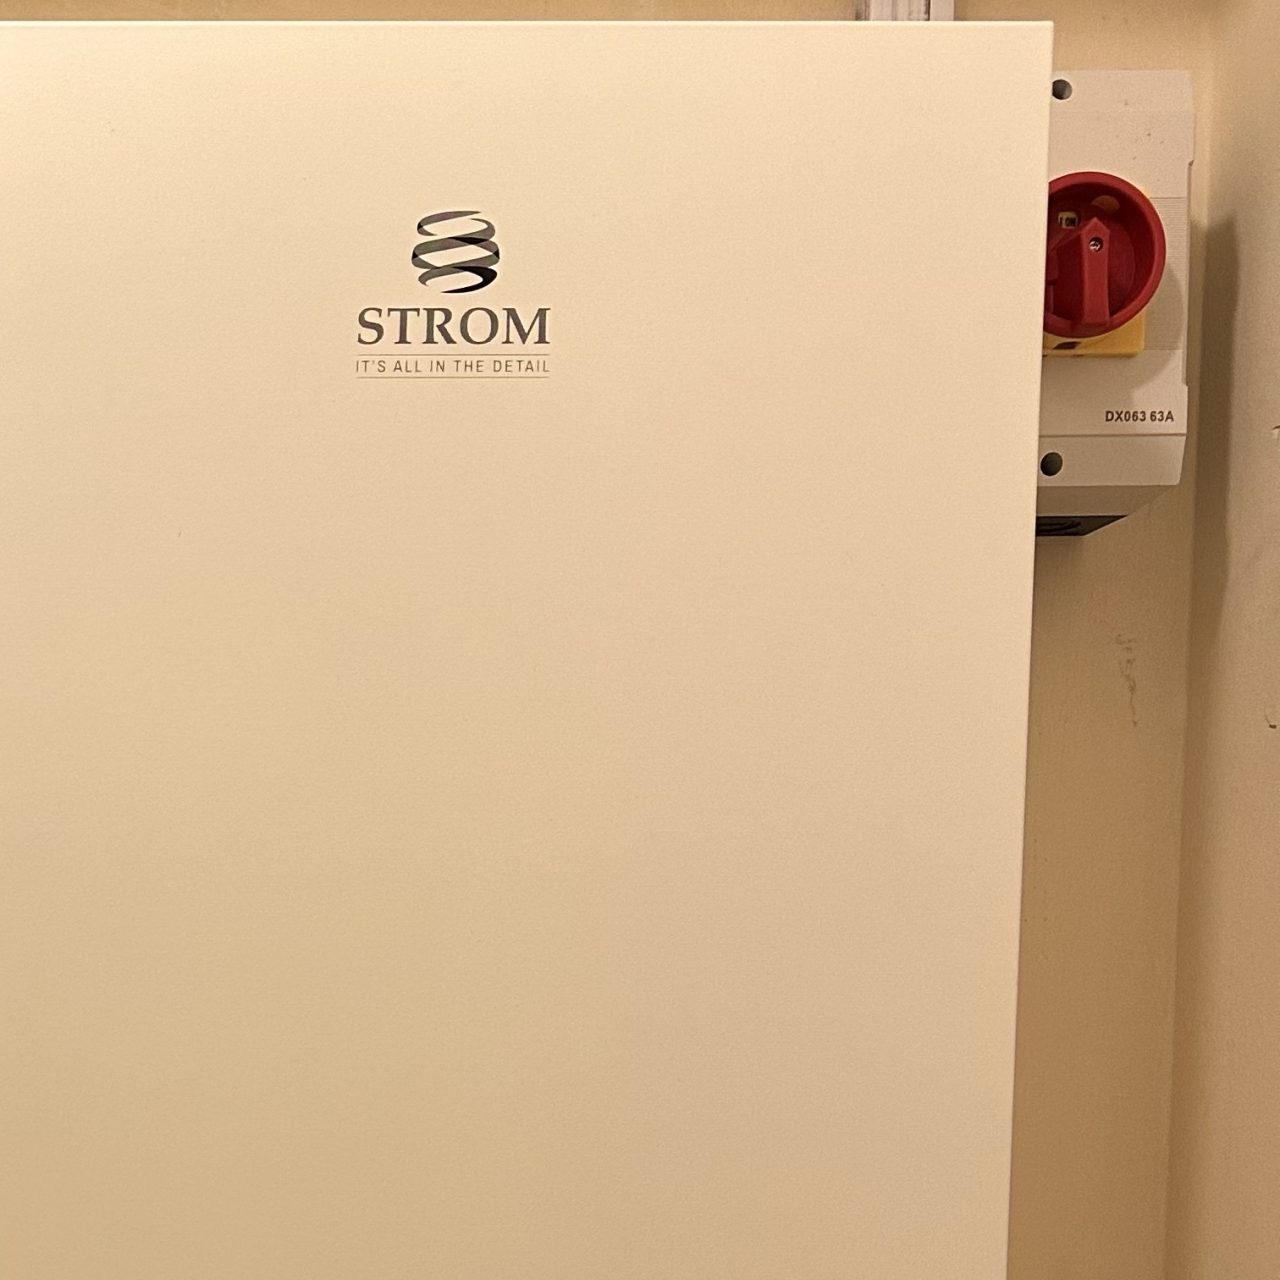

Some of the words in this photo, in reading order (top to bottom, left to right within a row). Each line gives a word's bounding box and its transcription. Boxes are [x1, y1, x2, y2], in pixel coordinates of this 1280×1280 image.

[357, 307, 552, 345] STROM
[355, 360, 386, 373] IT'S
[393, 360, 423, 373] ALL
[430, 360, 446, 373] IN
[453, 360, 484, 373] THE
[493, 360, 550, 373] DETAIL
[1105, 410, 1146, 422] DX063
[1150, 410, 1174, 422] 63A
